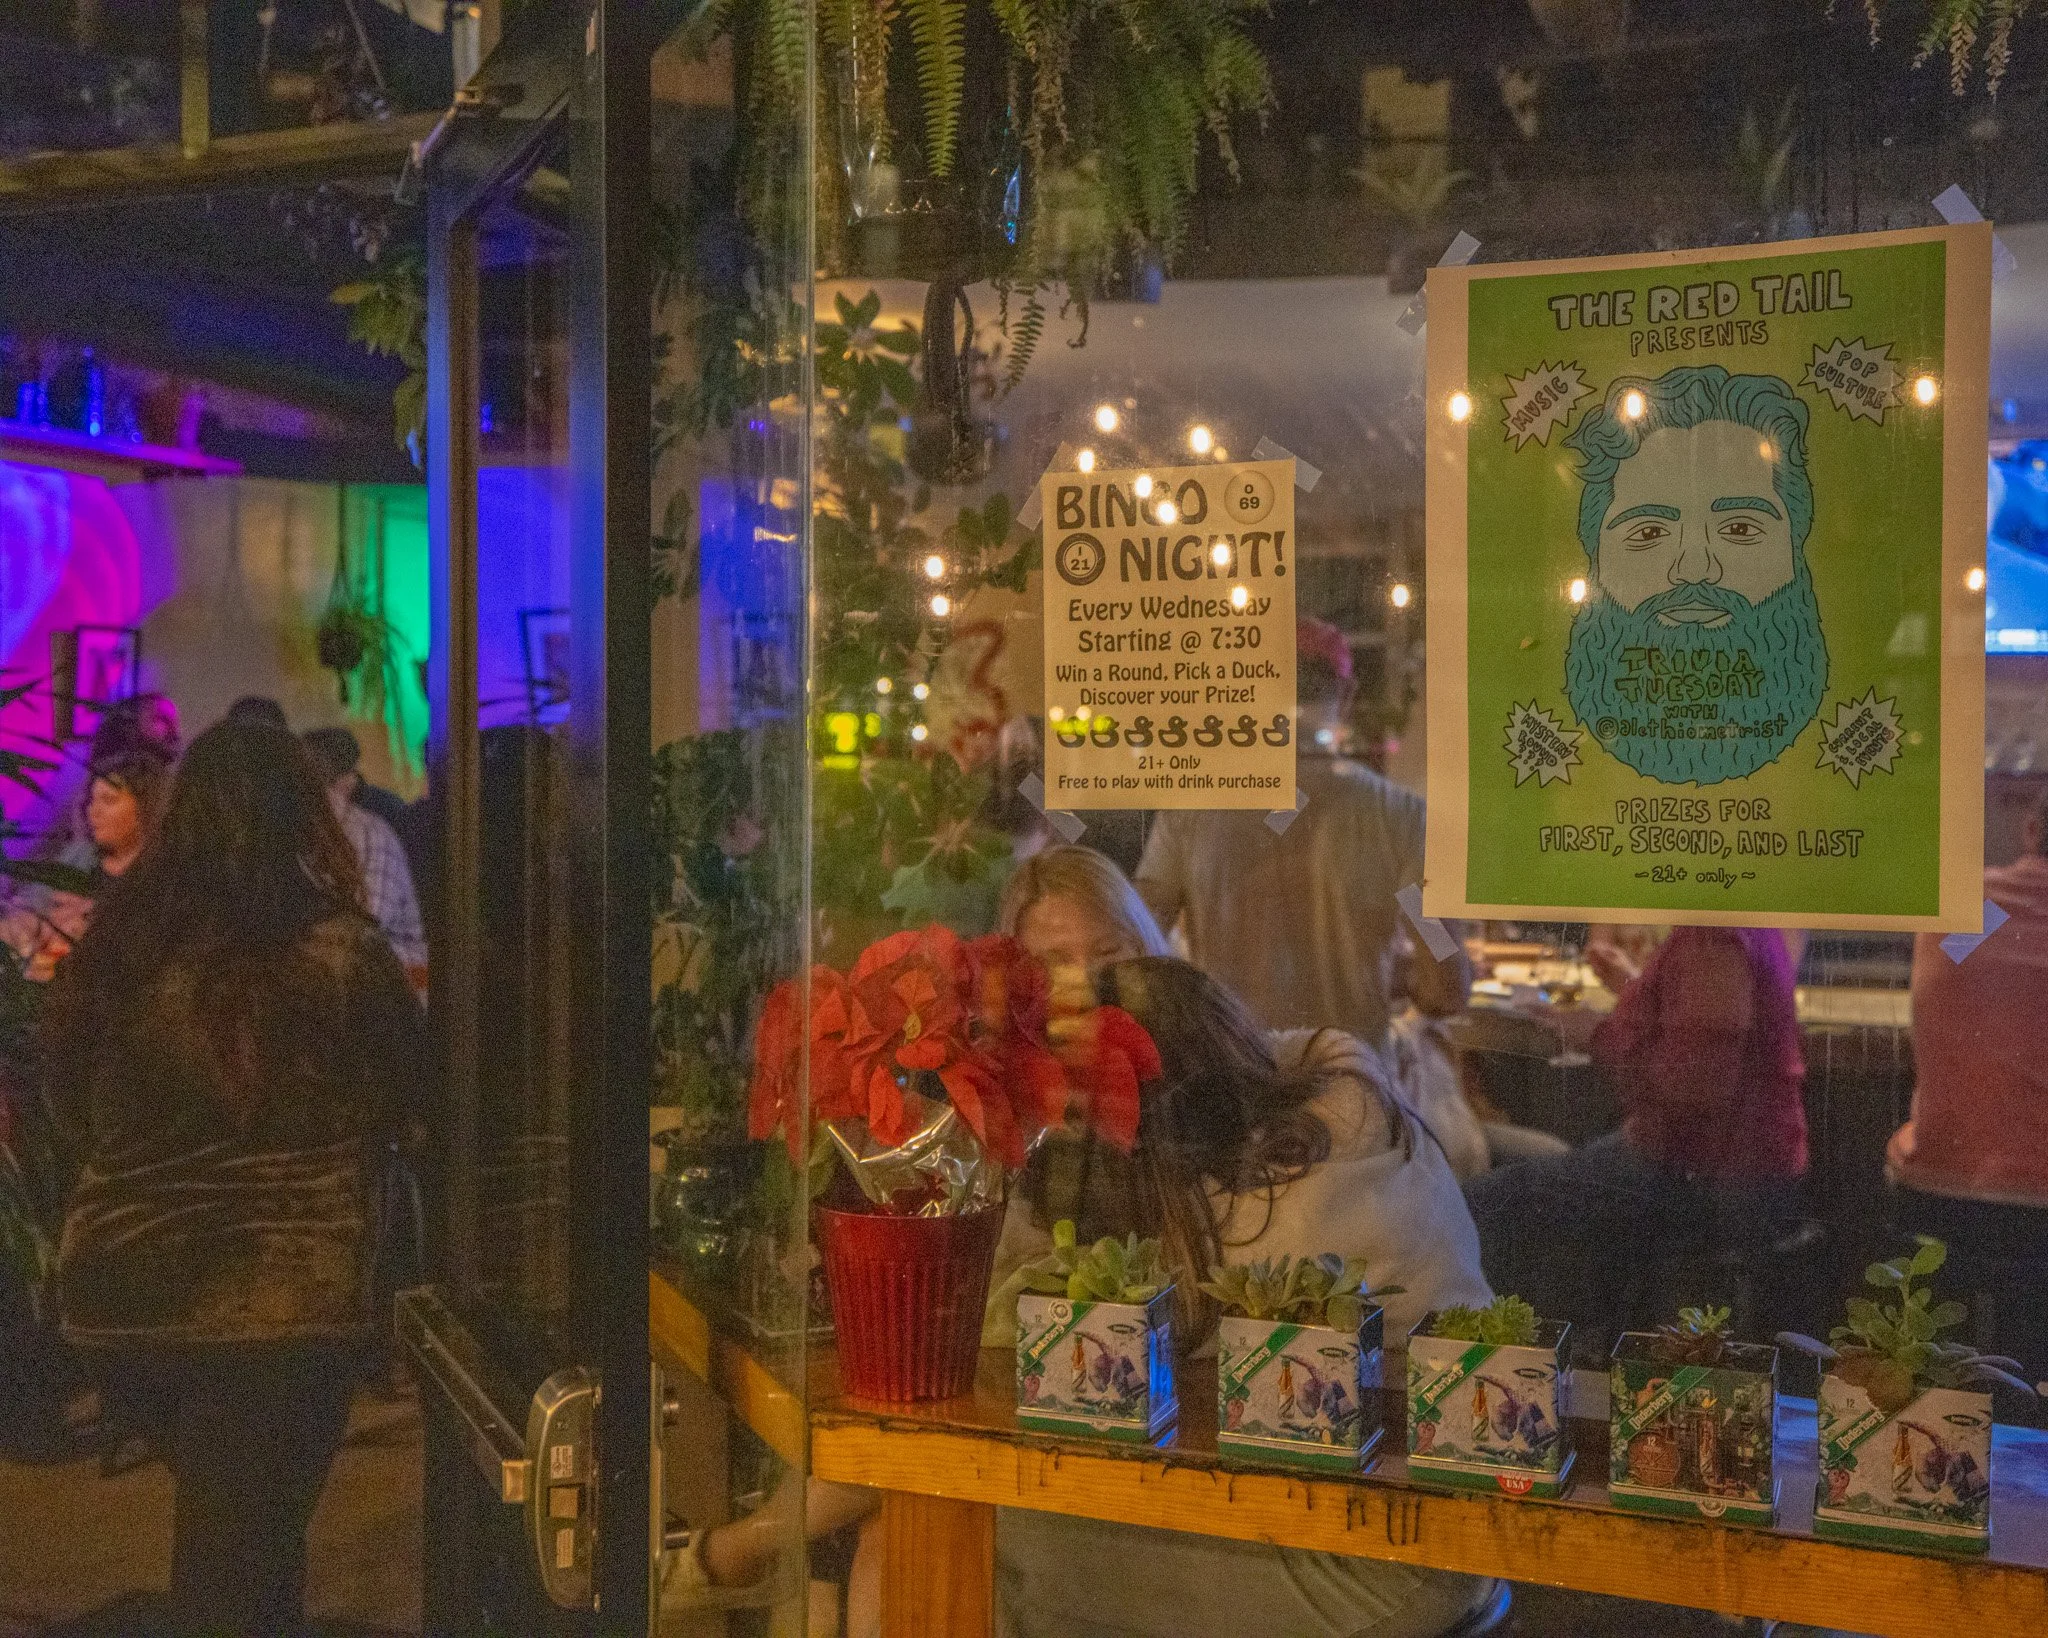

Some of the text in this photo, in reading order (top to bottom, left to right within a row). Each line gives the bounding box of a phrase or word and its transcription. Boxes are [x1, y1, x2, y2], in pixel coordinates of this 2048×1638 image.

[1548, 269, 1853, 331] THE RED TAIL
[1630, 320, 1769, 358] PRESENTS
[1837, 350, 1878, 378] POP
[1814, 361, 1887, 409] CULTURE
[1511, 376, 1568, 432] MUSIC
[1239, 496, 1260, 511] 69
[1070, 558, 1091, 572] 21
[1120, 530, 1286, 583] NIGHT!
[1069, 598, 1133, 622] Every
[1078, 626, 1261, 654] Starting @ 7:30
[1056, 660, 1280, 682] Win a Round, Pick a Duck,
[1619, 646, 1757, 676] TRIVIA
[1080, 685, 1255, 706] Discover your Prize!
[1614, 671, 1766, 704] TUESDAY
[1663, 704, 1718, 720] WITH
[1521, 713, 1573, 759] MYSTERY
[1828, 707, 1873, 753] CURRENT
[1846, 721, 1883, 755] LOCAL
[1518, 730, 1557, 767] ROUND
[1855, 726, 1895, 766] EVENTS
[1138, 755, 1201, 771] 21+ Only
[1058, 774, 1281, 790] Free to play with drink purchase
[1615, 797, 1771, 824] PRIZES FOR
[1539, 825, 1864, 859] FIRST, SECOND, AND LAST
